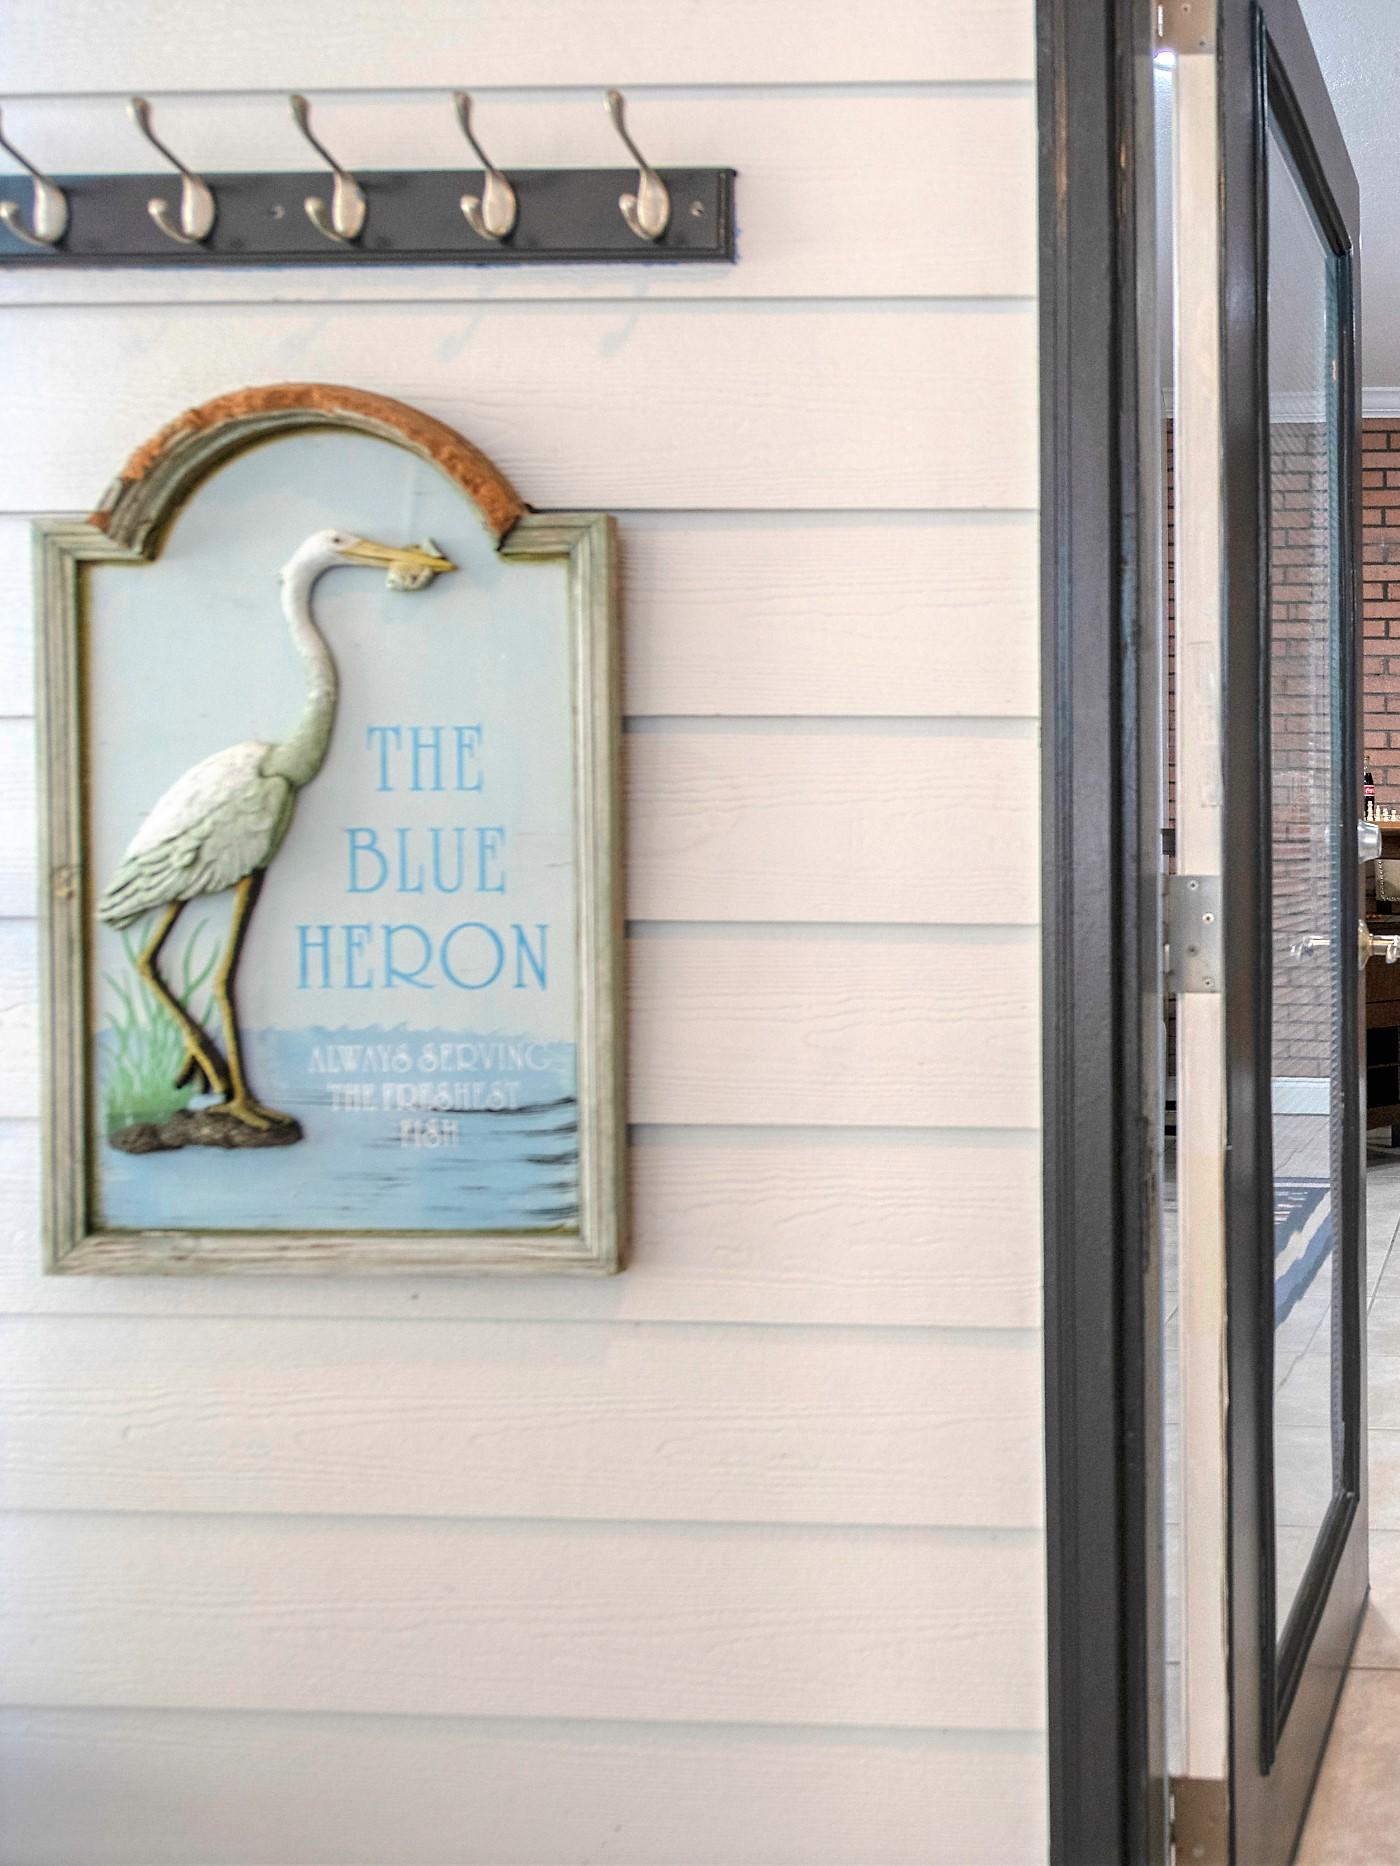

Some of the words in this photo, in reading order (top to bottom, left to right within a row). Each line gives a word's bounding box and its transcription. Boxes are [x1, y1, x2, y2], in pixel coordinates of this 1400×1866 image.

[366, 724, 484, 793] THE
[345, 826, 507, 895] BLUE
[295, 921, 550, 992] HERON
[309, 1043, 413, 1073] ALWAYS
[417, 1042, 551, 1072] SERVING
[327, 1081, 378, 1112] THE
[382, 1081, 521, 1111] FRESHEST
[399, 1118, 460, 1149] FISH
